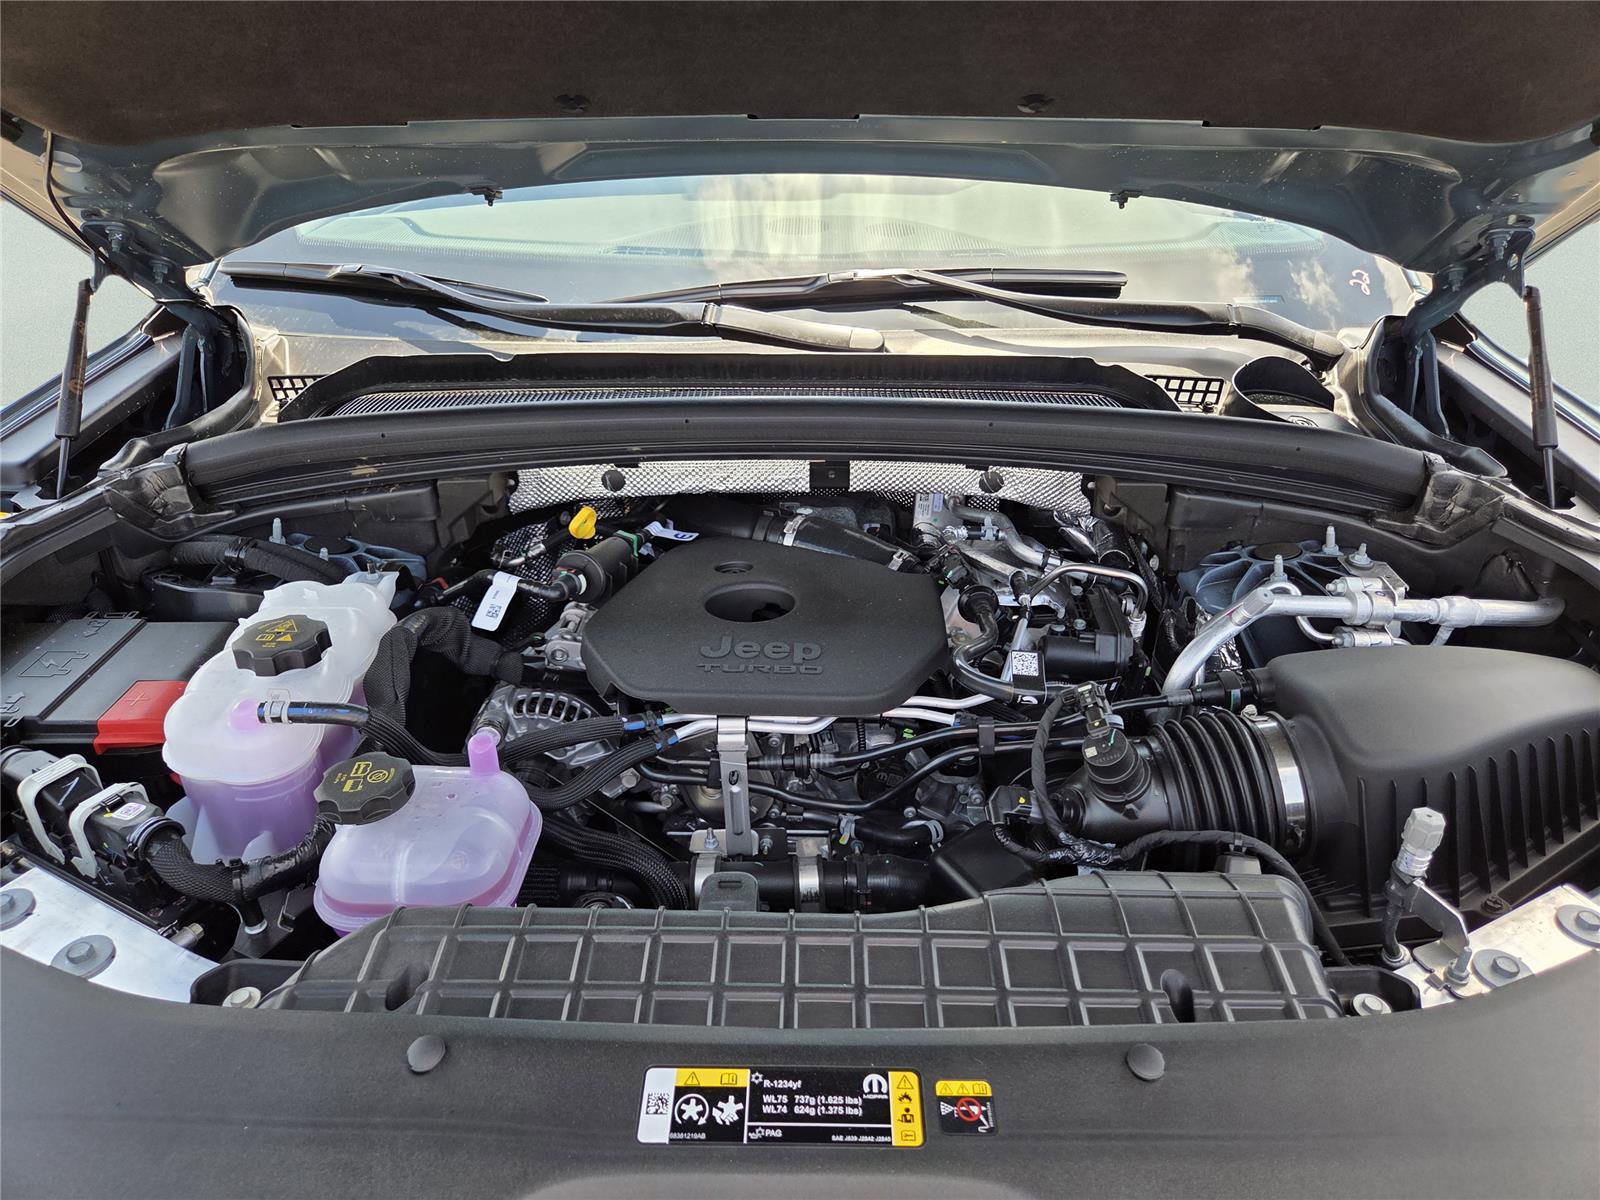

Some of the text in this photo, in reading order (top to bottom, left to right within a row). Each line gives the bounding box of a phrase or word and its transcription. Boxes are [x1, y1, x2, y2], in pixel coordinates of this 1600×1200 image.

[700, 635, 822, 665] Jeep
[696, 663, 823, 675] TURBO
[763, 1079, 802, 1091] R-1234yf
[762, 1094, 863, 1107] WL75 737g (1.625 lbs)
[762, 1105, 863, 1118] WL74 624g (1.375 lbs)
[764, 1129, 783, 1138] PAG
